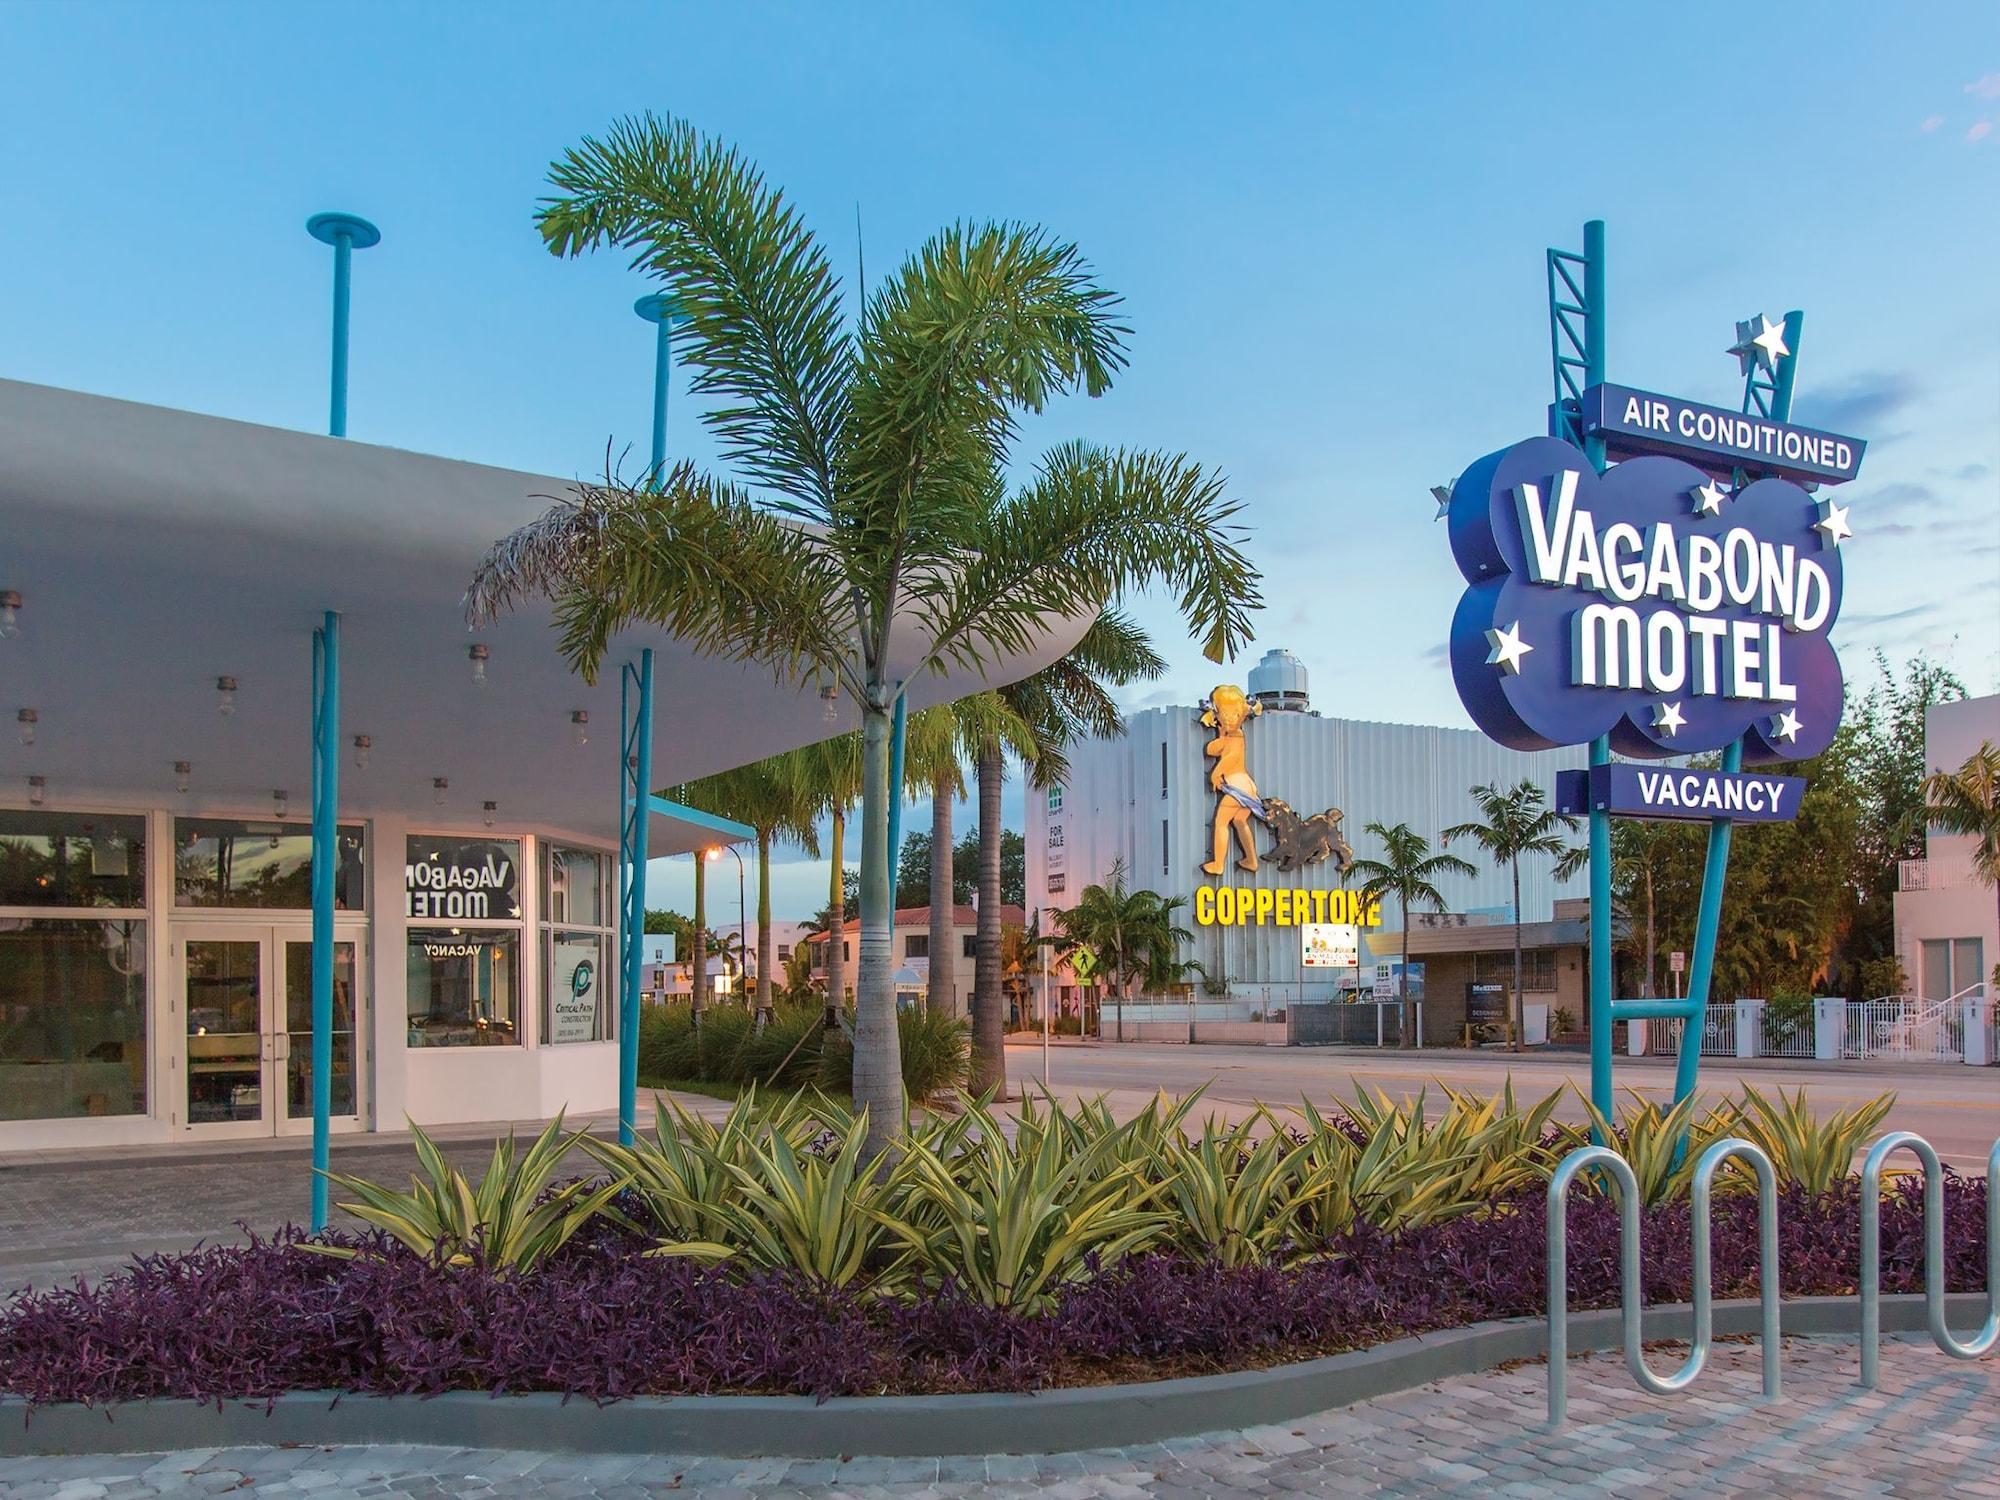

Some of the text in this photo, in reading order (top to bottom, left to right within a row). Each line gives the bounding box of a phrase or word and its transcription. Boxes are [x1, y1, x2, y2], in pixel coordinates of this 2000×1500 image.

[1624, 396, 1853, 471] AIR CONDITIONED
[1518, 469, 1831, 633] VAGABOND
[1578, 603, 1797, 701] MOTEL
[1637, 771, 1785, 814] VACANCY
[1048, 836, 1064, 848] SALE
[1050, 825, 1063, 837] FOR
[1195, 885, 1383, 927] COPPERTONE
